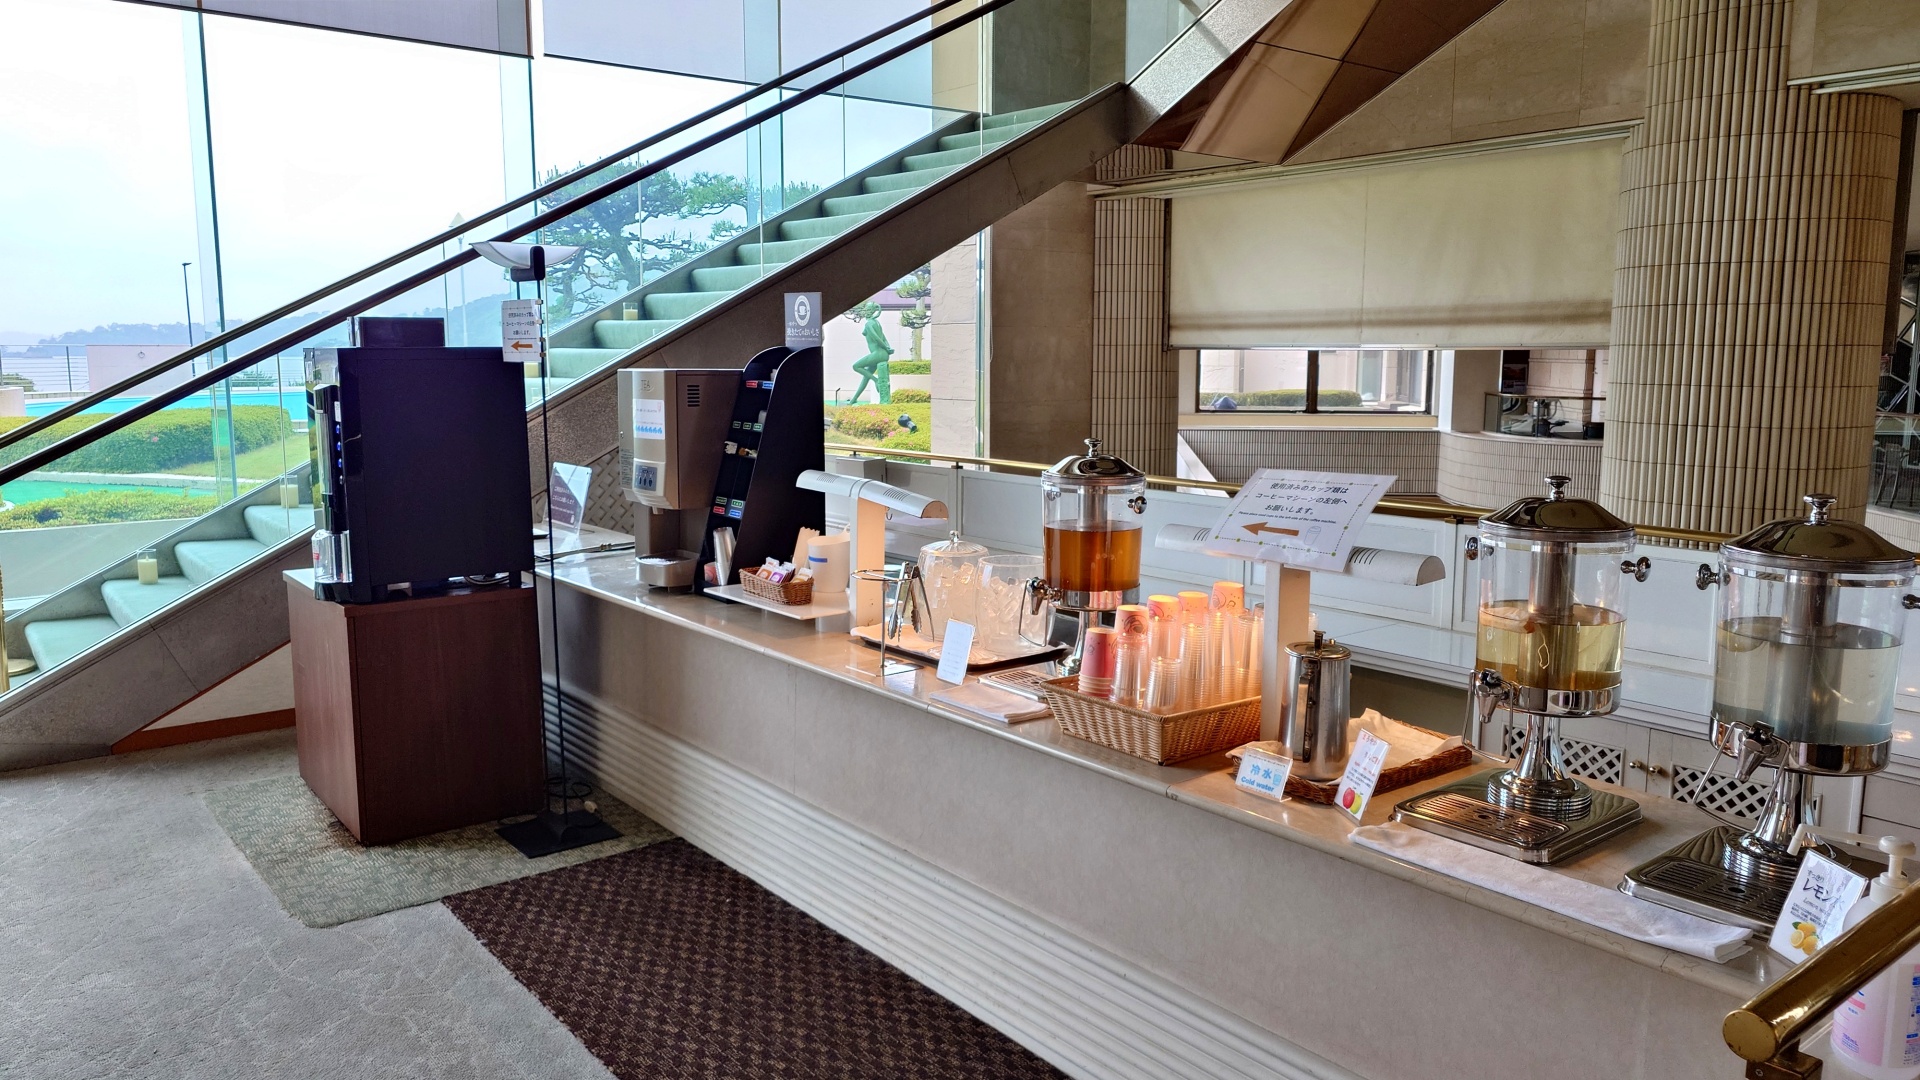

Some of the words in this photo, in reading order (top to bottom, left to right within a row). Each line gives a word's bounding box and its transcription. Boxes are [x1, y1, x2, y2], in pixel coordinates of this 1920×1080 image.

[1270, 482, 1349, 494] 使用済みのカップ類は
[1255, 493, 1348, 505] コーヒーマシーンの左側へ
[1264, 504, 1314, 515] お願いします。
[1241, 775, 1256, 786] Cold
[1256, 781, 1275, 792] water
